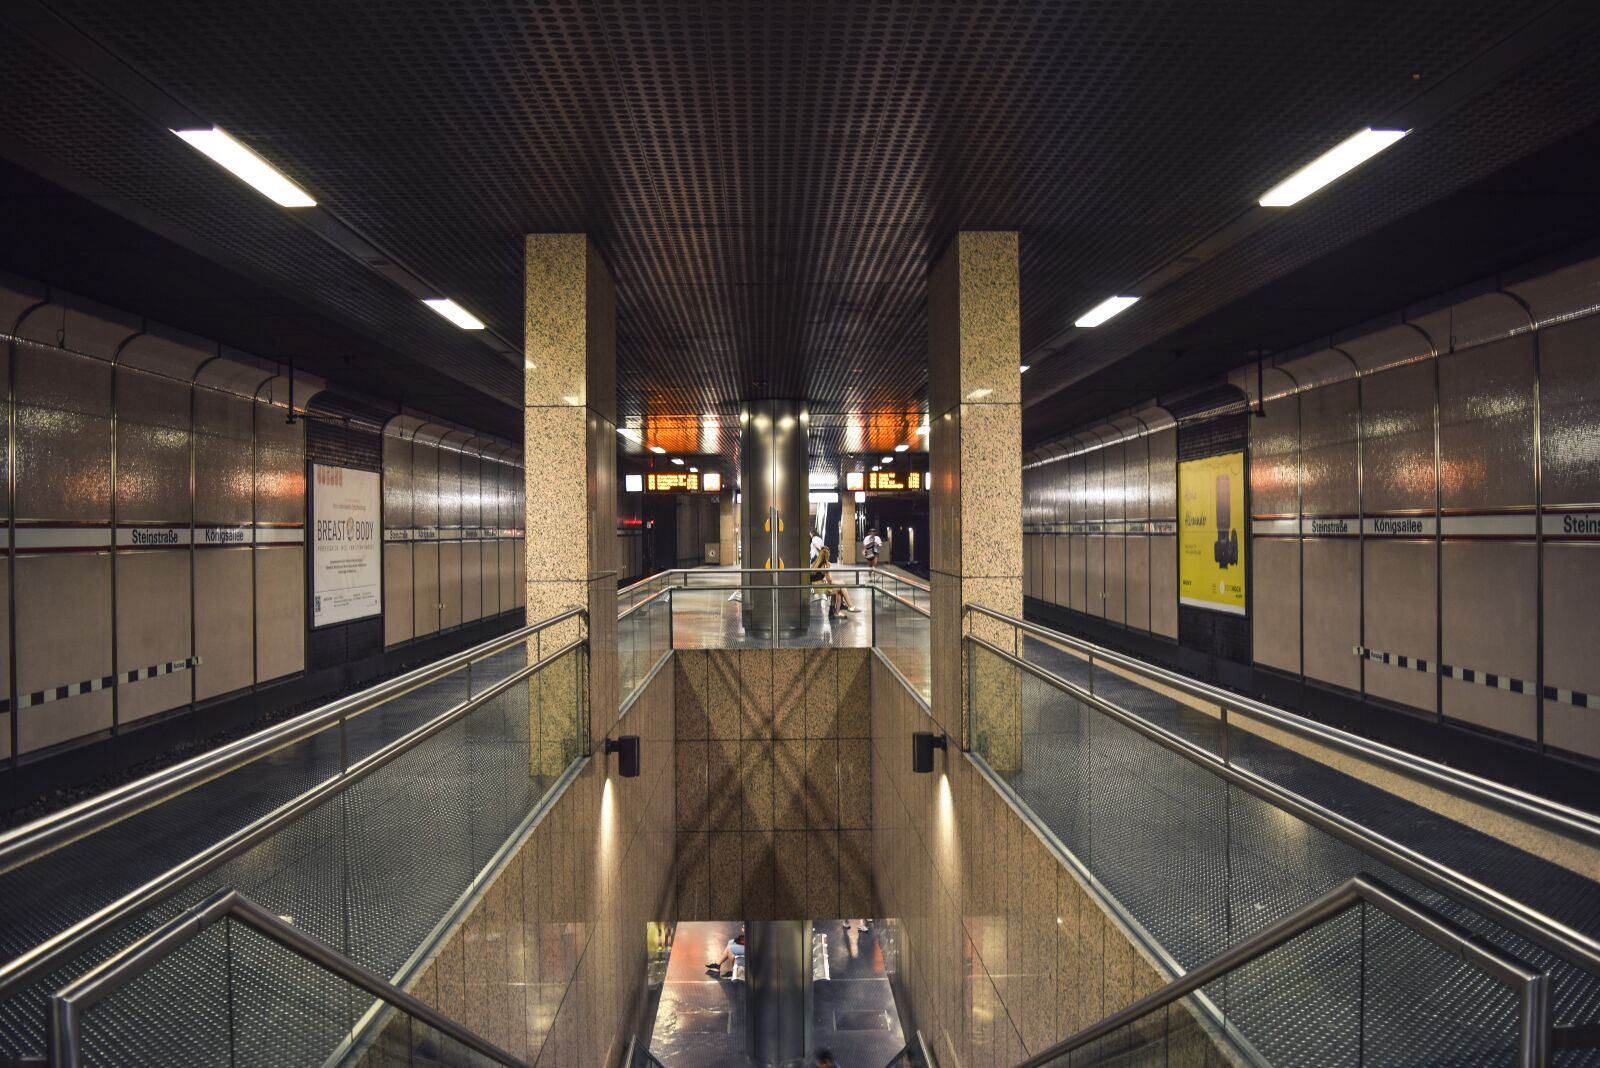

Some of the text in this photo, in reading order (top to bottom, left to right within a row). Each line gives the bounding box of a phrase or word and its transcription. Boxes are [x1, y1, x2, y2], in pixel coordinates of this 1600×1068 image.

[317, 520, 346, 541] BREAST
[355, 521, 374, 541] BODY
[1312, 519, 1423, 534] Steinstraße Königsallee
[131, 528, 244, 544] Steinstraße Königsallee
